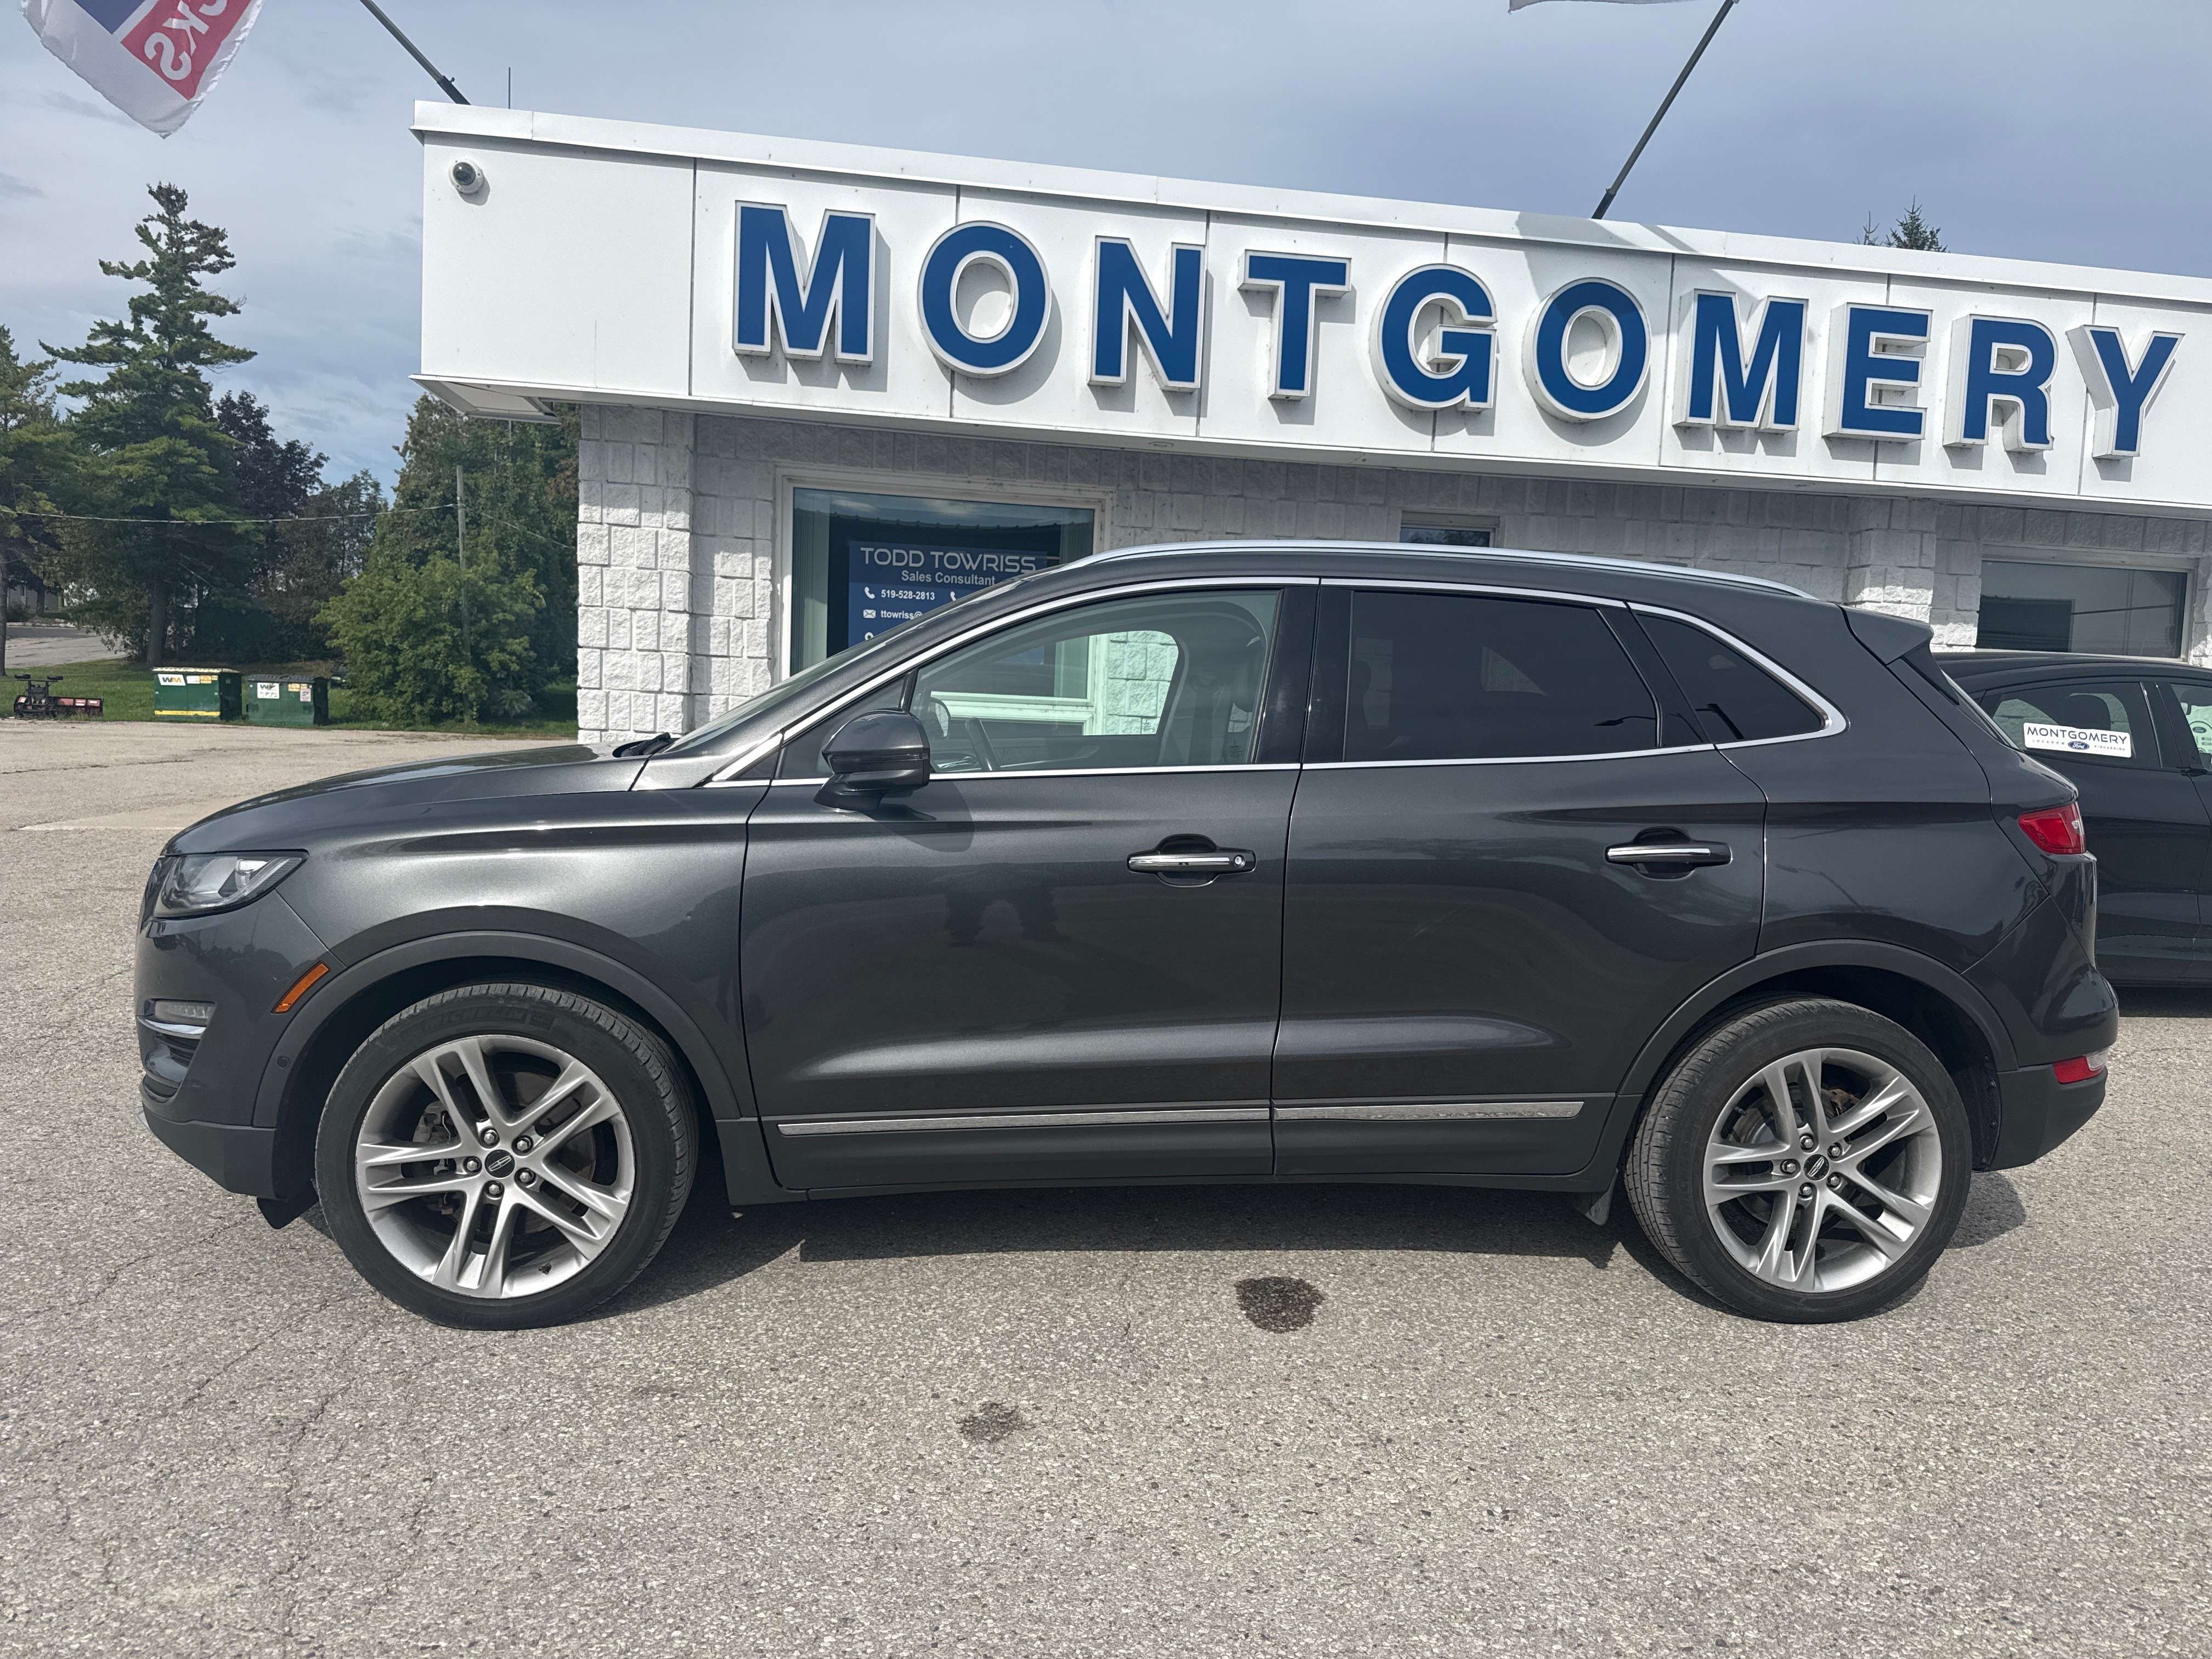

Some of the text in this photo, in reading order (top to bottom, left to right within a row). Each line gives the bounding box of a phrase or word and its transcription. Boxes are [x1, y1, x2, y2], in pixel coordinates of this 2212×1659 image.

[733, 200, 2185, 459] MONTGOMERY
[860, 546, 1036, 573] TODD TOWRISS
[901, 569, 996, 586] Sales Consultant
[881, 589, 935, 601] 519-528-2813
[2027, 726, 2127, 744] MONTGOMERY
